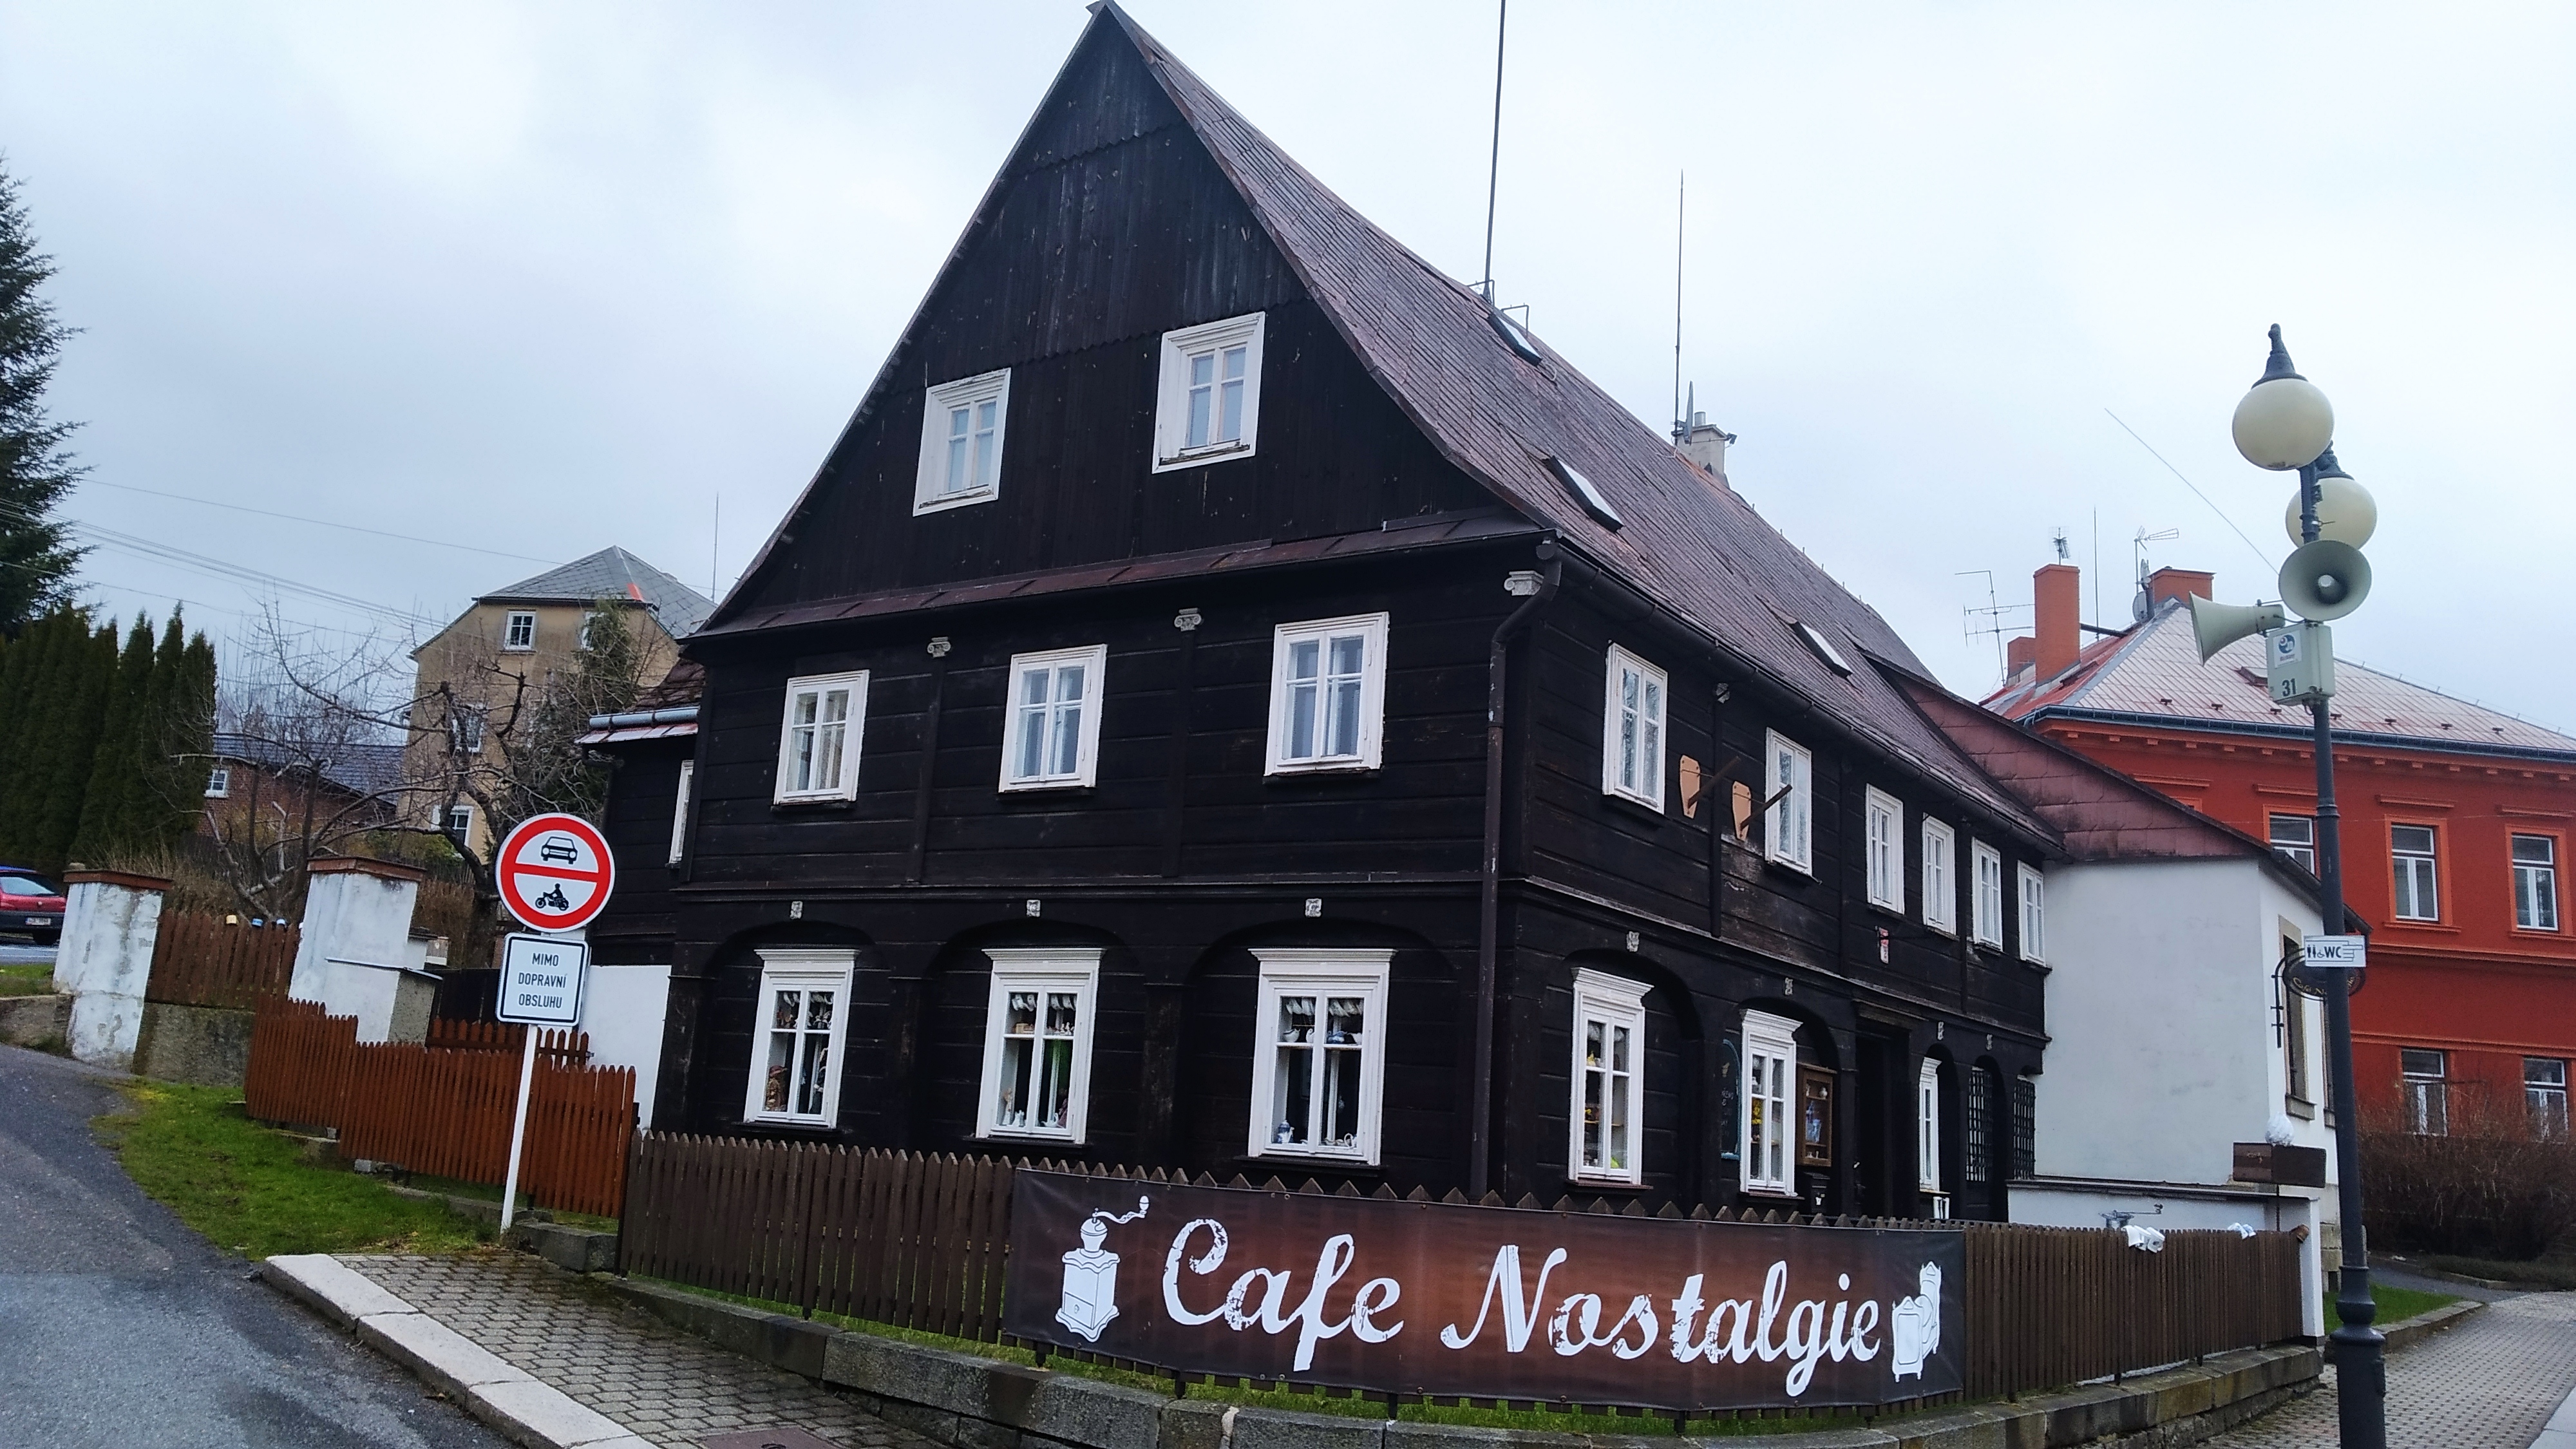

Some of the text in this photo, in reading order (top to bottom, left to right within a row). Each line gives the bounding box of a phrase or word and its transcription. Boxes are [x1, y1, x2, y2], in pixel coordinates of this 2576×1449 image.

[2282, 678, 2297, 697] 31
[532, 952, 559, 967] MIMO
[2324, 946, 2342, 958] WC
[518, 972, 567, 989] DOPRAVNÍ
[518, 994, 562, 1009] OBSLUHU
[1163, 1218, 1880, 1397] Cafe Nostalgie
